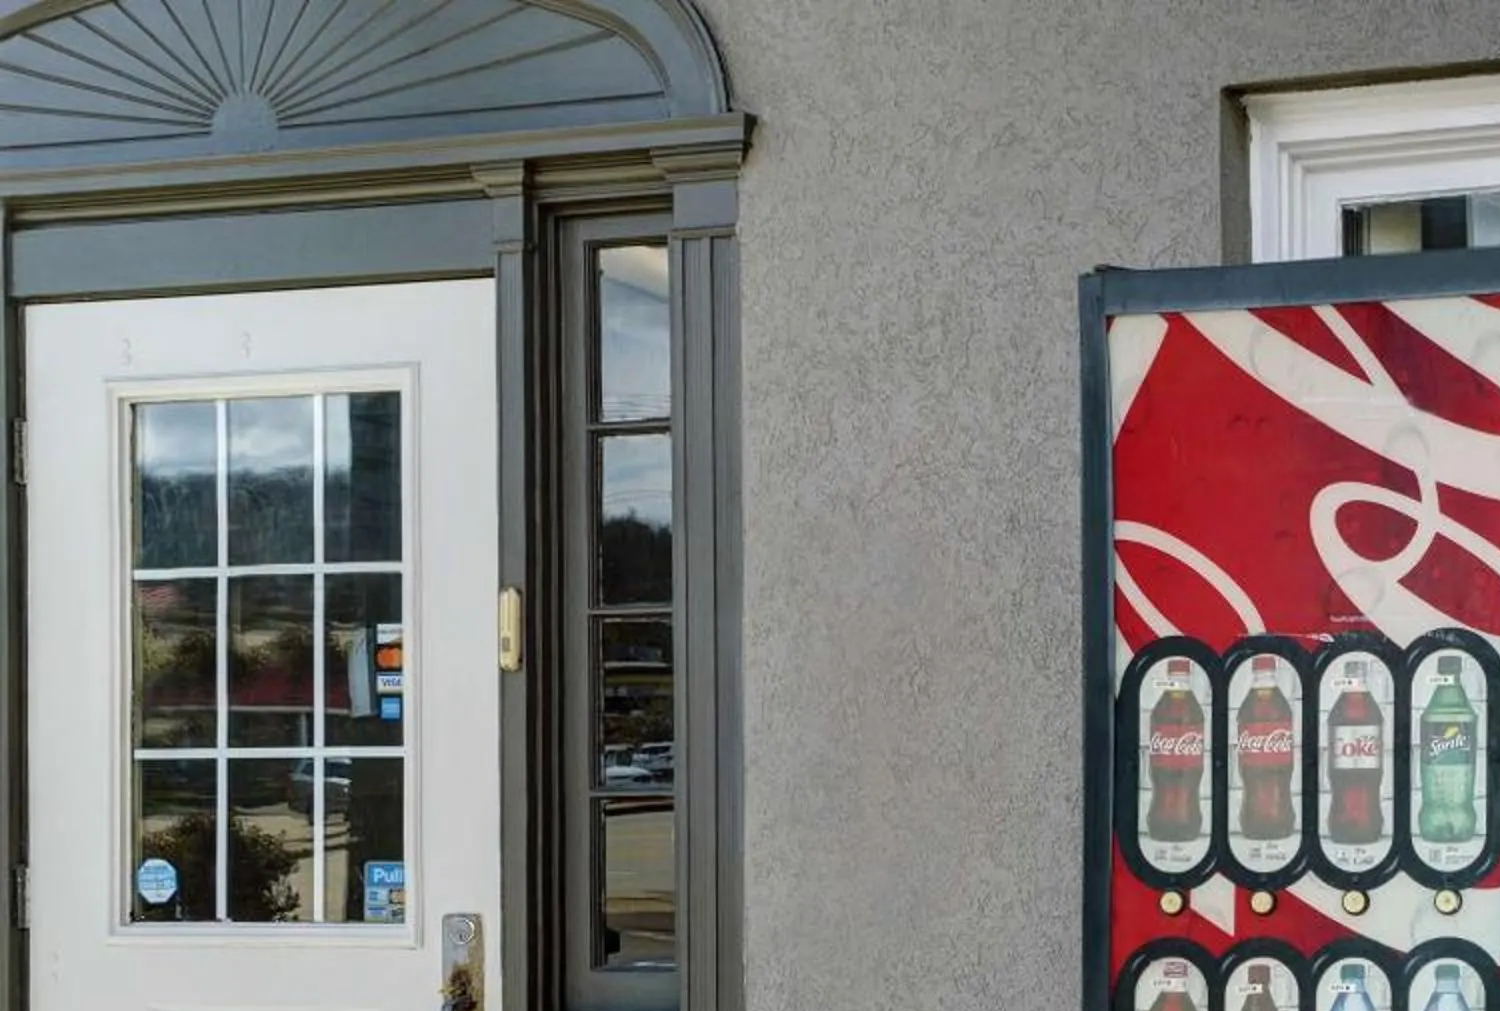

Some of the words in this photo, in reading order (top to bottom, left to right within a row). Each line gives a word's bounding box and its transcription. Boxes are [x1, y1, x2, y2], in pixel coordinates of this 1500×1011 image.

[1150, 731, 1203, 756] Coca-Cola
[1238, 728, 1293, 753] Coca-Cola
[1429, 734, 1468, 757] Sprite
